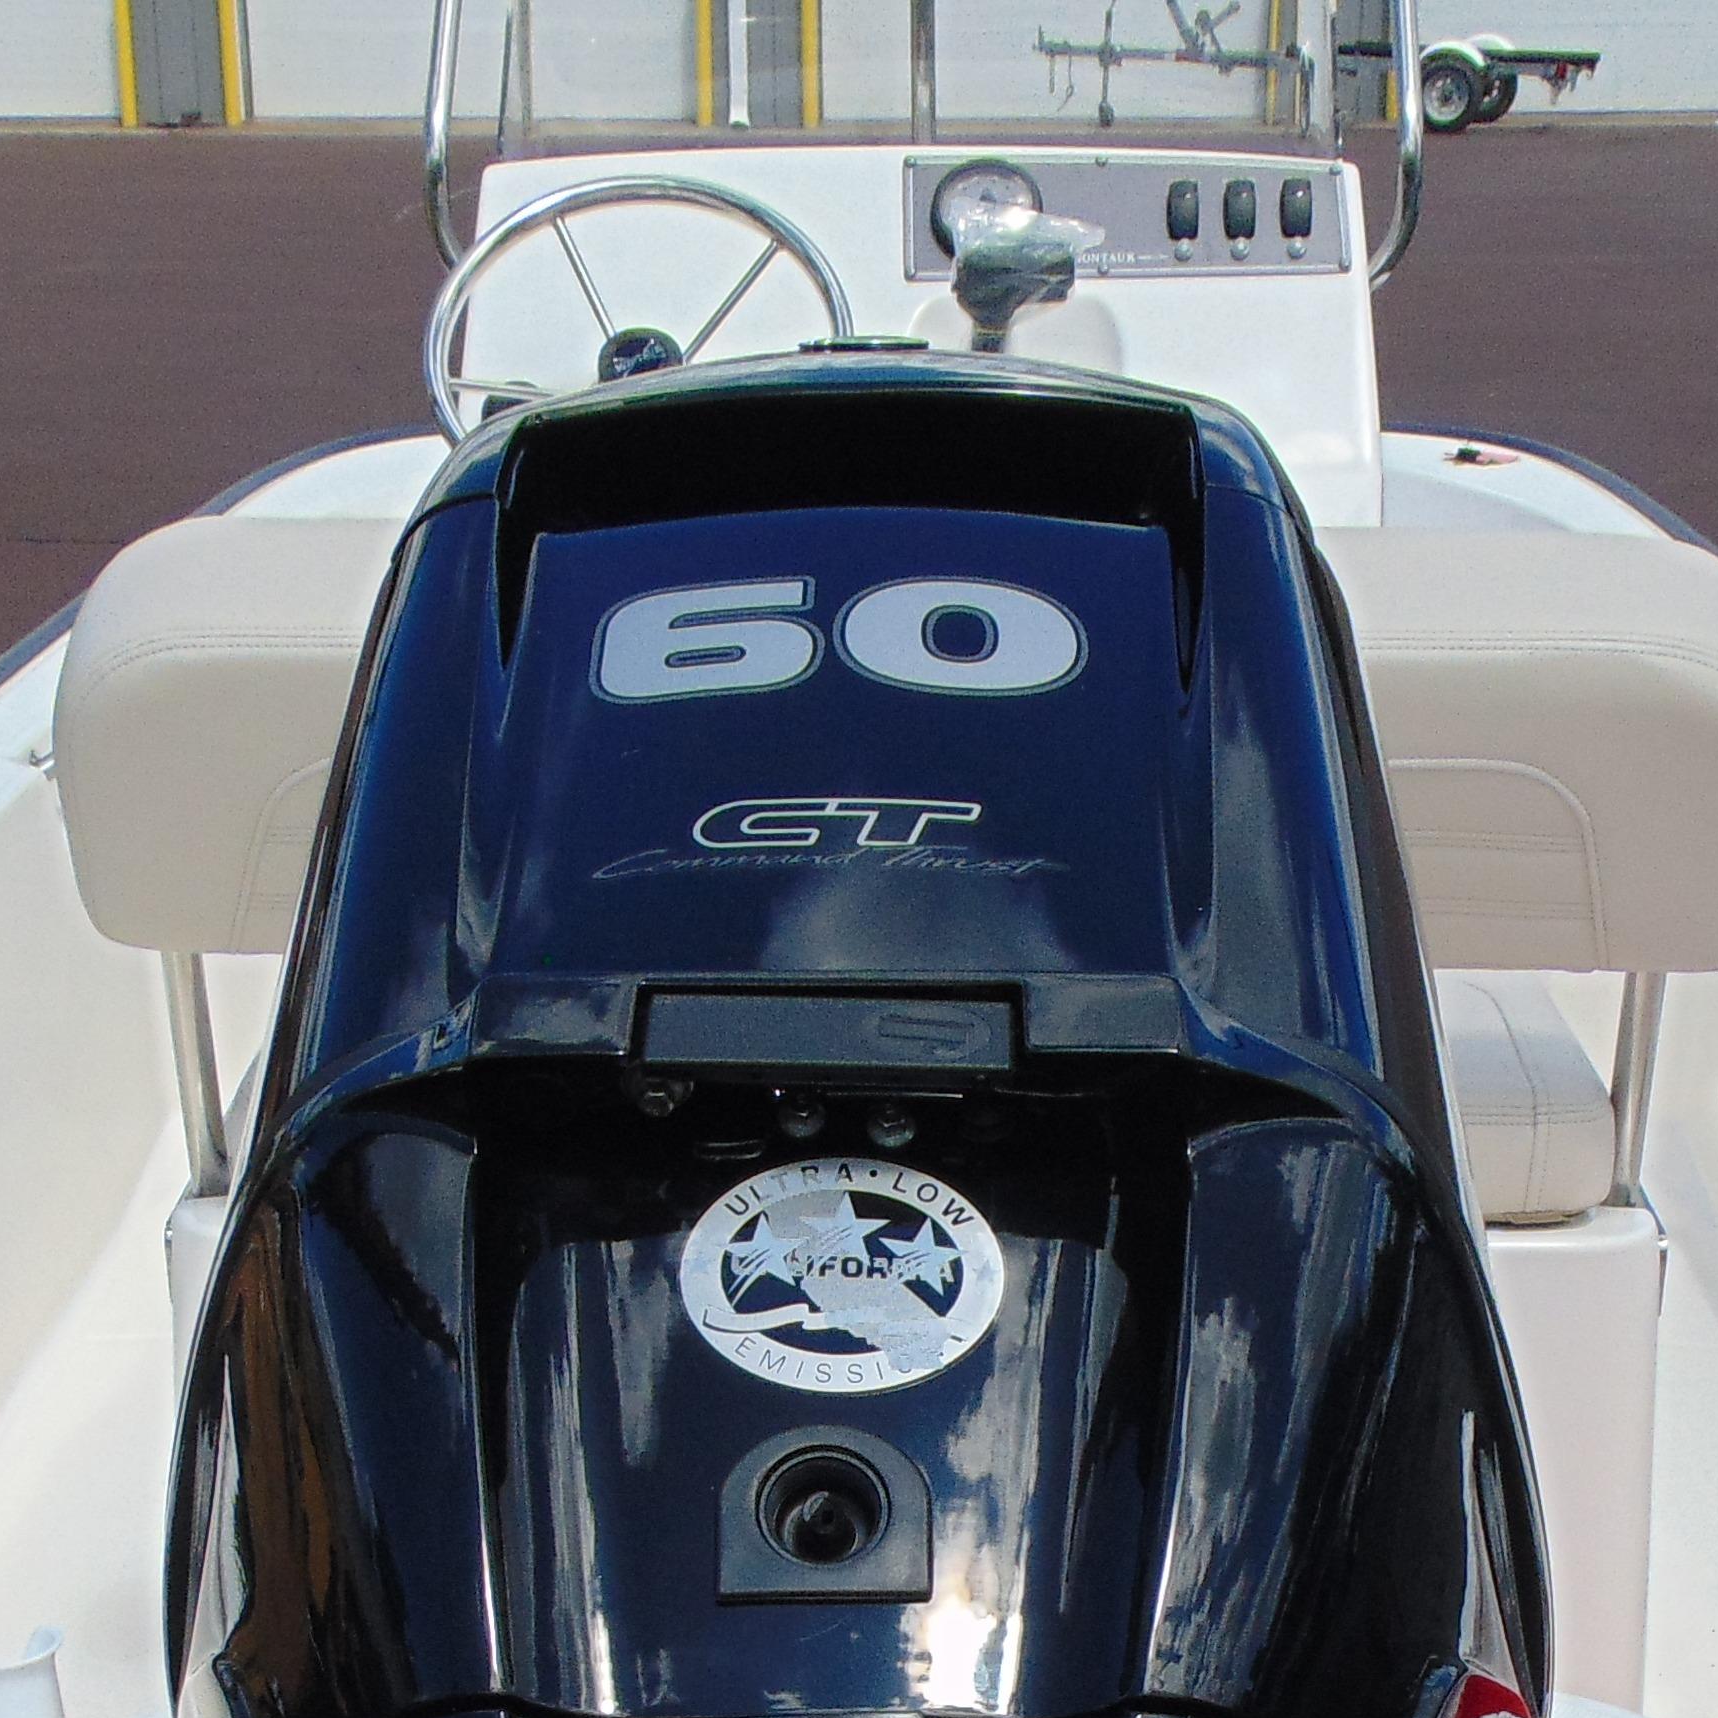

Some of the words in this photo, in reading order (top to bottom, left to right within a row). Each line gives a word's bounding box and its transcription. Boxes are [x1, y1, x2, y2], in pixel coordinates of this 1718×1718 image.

[588, 575, 1089, 704] 60
[692, 798, 982, 848] GT
[592, 847, 870, 880] Command
[882, 845, 1071, 876] Thrust
[891, 1171, 975, 1227] LOW
[734, 1335, 967, 1384] EMISSI
